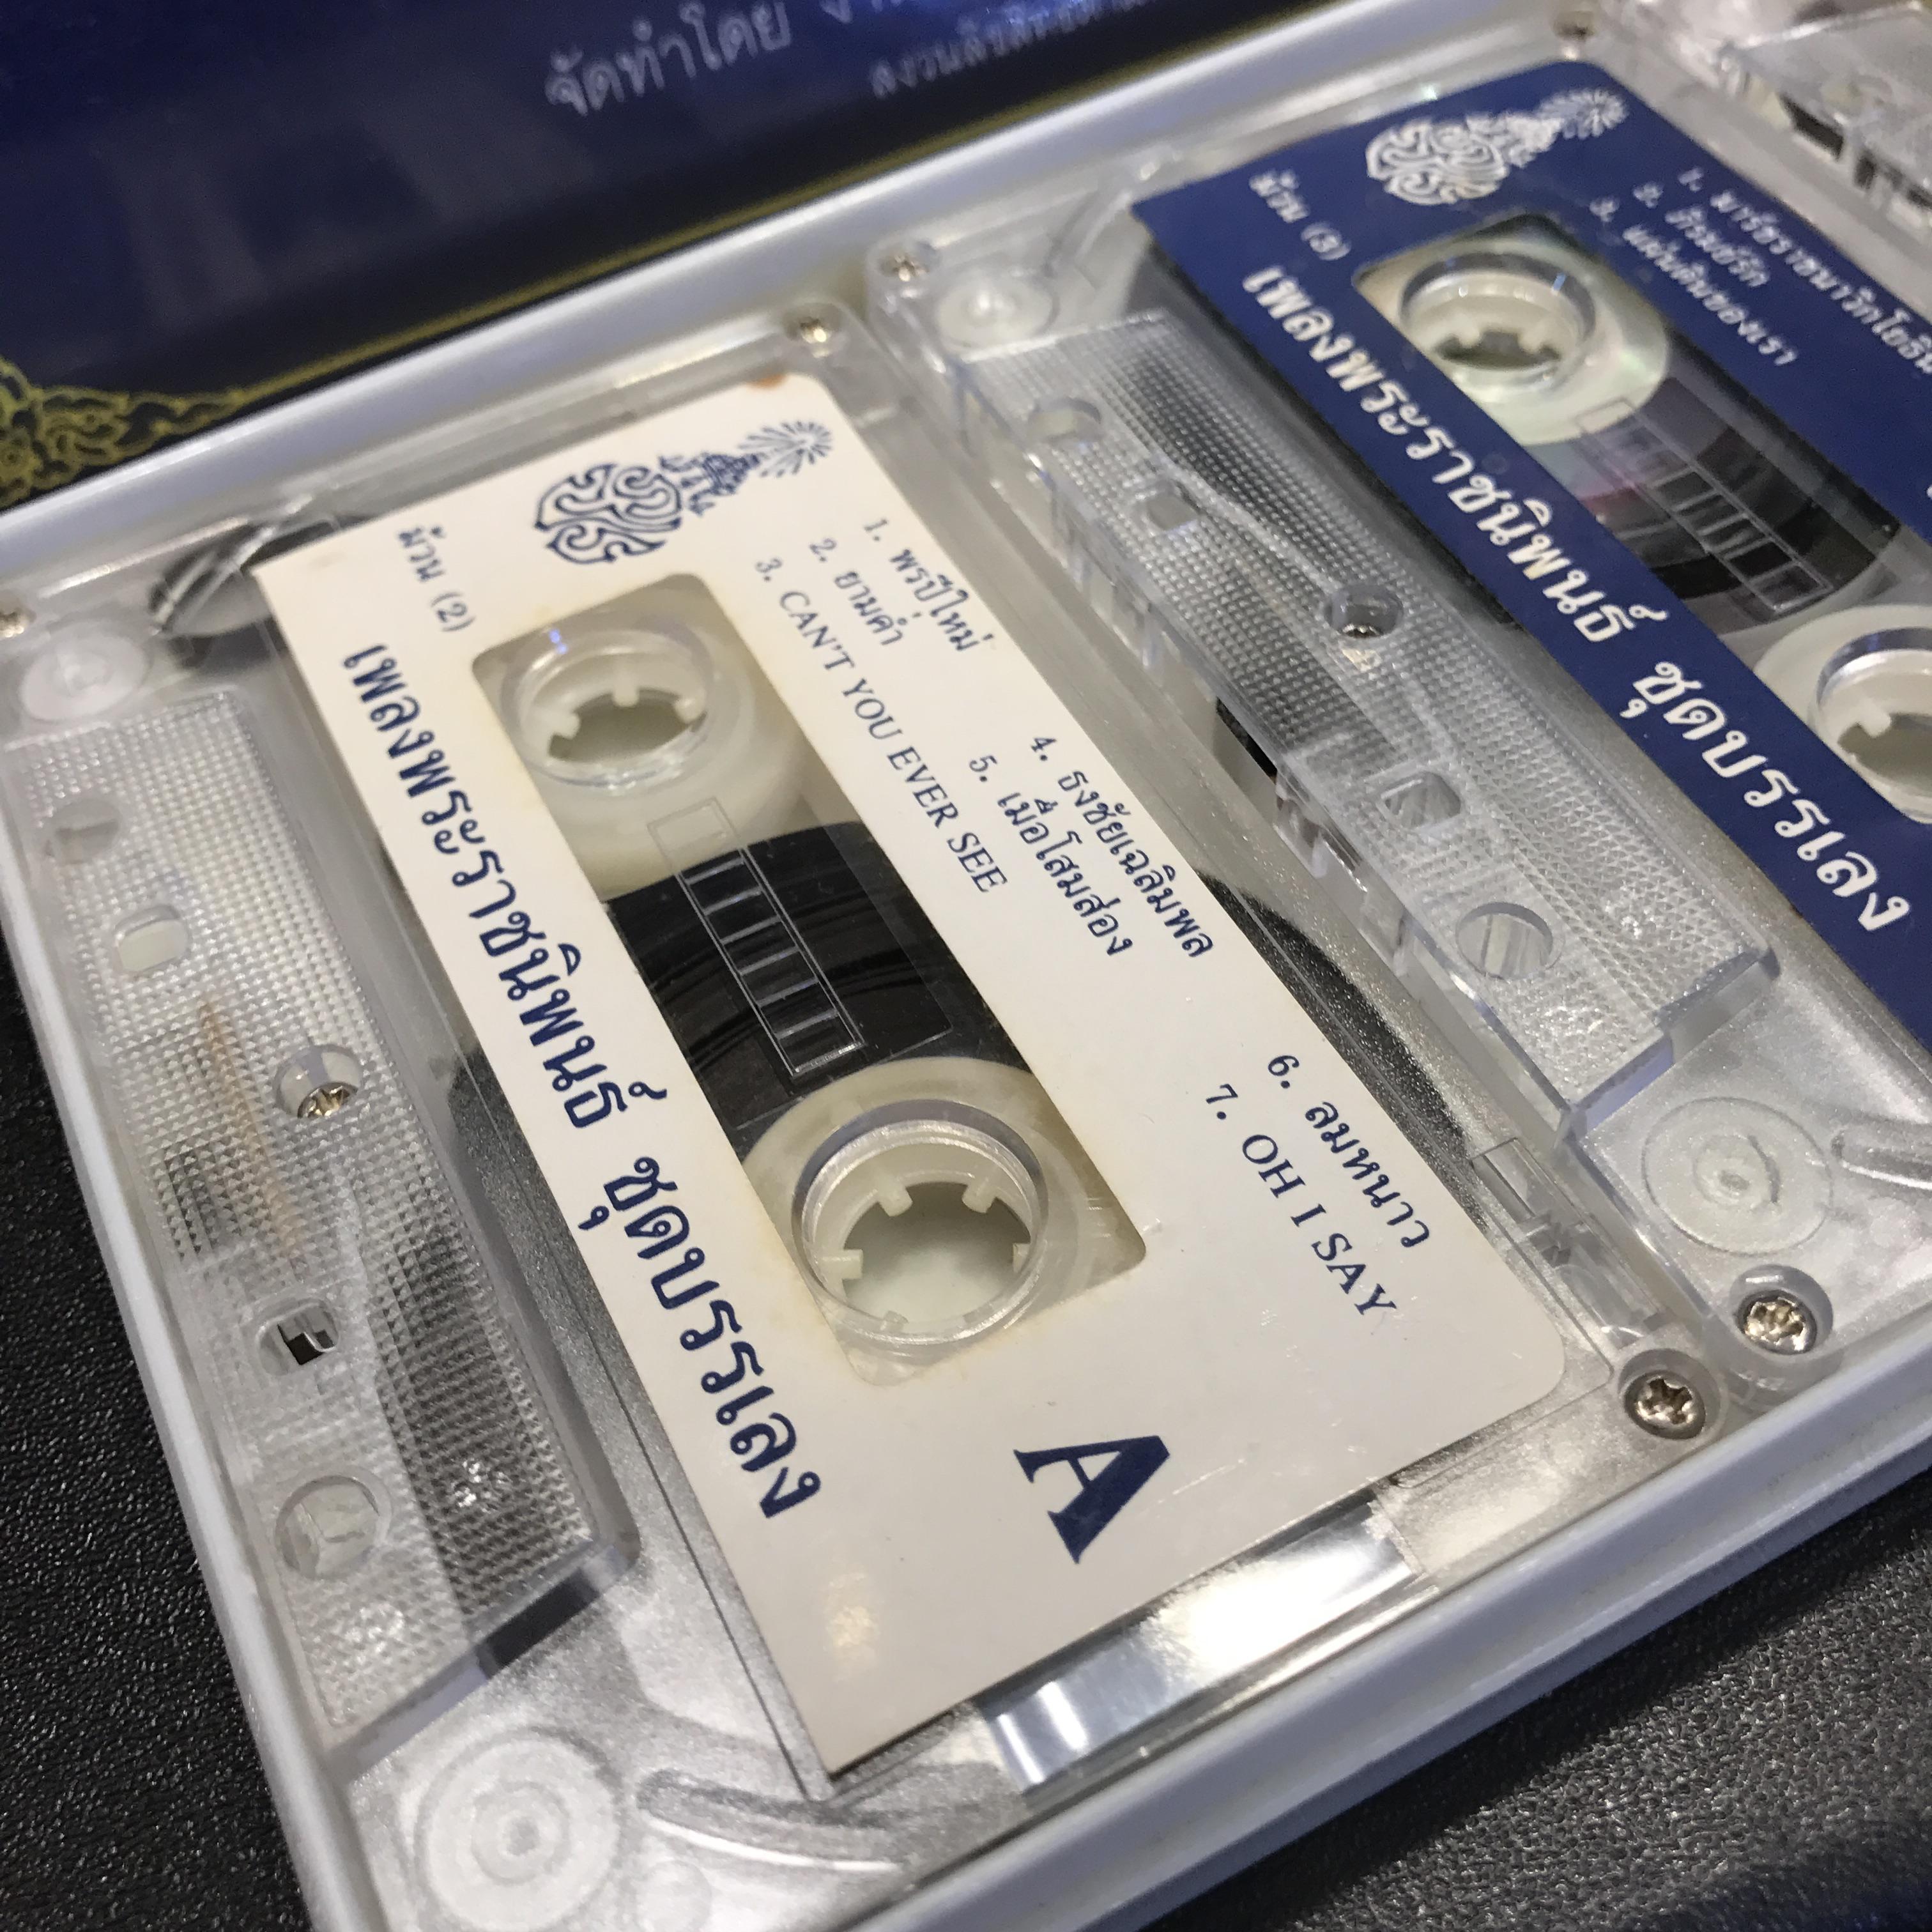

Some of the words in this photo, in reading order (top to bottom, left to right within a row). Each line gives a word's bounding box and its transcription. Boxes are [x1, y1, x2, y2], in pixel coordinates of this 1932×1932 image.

[395, 525, 447, 582] ม้วน
[430, 591, 475, 633] (2)
[809, 537, 838, 563] 2.
[833, 571, 922, 645] ยามค่ำ
[863, 518, 889, 542] 1.
[889, 547, 994, 652] พรปีใหม่
[1243, 267, 1669, 643] เพลงพระราชนิพนธ์
[1620, 661, 1910, 931] ชุดบรรเลง
[755, 557, 783, 581] 3.
[779, 590, 855, 671] CAN'T
[841, 678, 902, 740] YOU
[887, 745, 960, 829] EVER
[947, 832, 1008, 894] SEE
[969, 755, 998, 783] 5.
[997, 792, 1133, 956] เมื่อโสมส่อง
[1030, 736, 1057, 762] 4.
[1057, 770, 1214, 958] ธงชัยเฉลิมพล
[342, 641, 668, 1131] เพลงพระราชนิพนธ์
[578, 1156, 821, 1519] ชุดบรรเลง
[1268, 1054, 1300, 1090] 6.
[1305, 1101, 1430, 1248] ลมหนาว
[1205, 1084, 1239, 1121] 7.
[1242, 1134, 1306, 1198] OH
[1291, 1204, 1326, 1228] I
[1312, 1232, 1397, 1316] SAY
[1013, 1434, 1171, 1565] A
